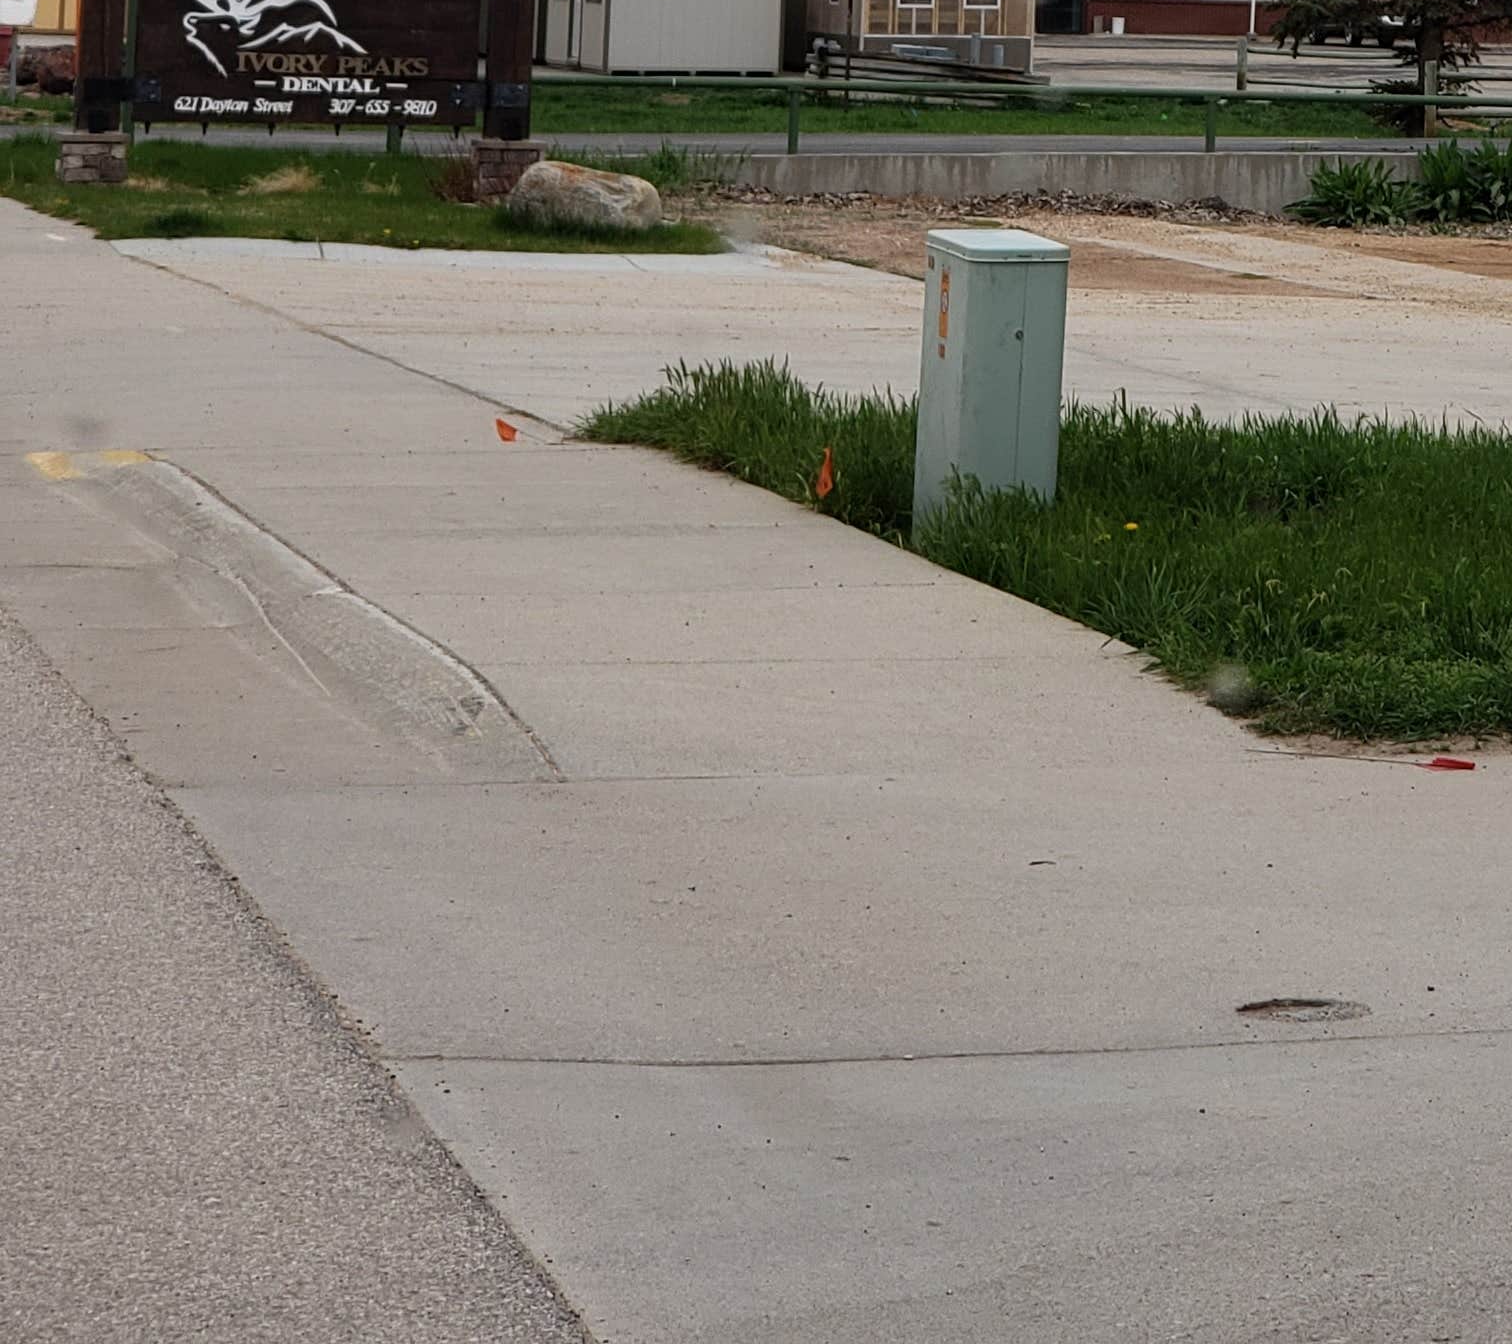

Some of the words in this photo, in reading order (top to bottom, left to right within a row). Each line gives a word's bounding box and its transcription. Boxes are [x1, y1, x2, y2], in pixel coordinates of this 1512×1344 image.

[237, 51, 328, 75] IVORY
[338, 56, 429, 77] PEAKS
[282, 76, 380, 93] DENTAL
[174, 97, 198, 112] 621
[199, 97, 249, 113] Dayton
[253, 97, 294, 113] Street
